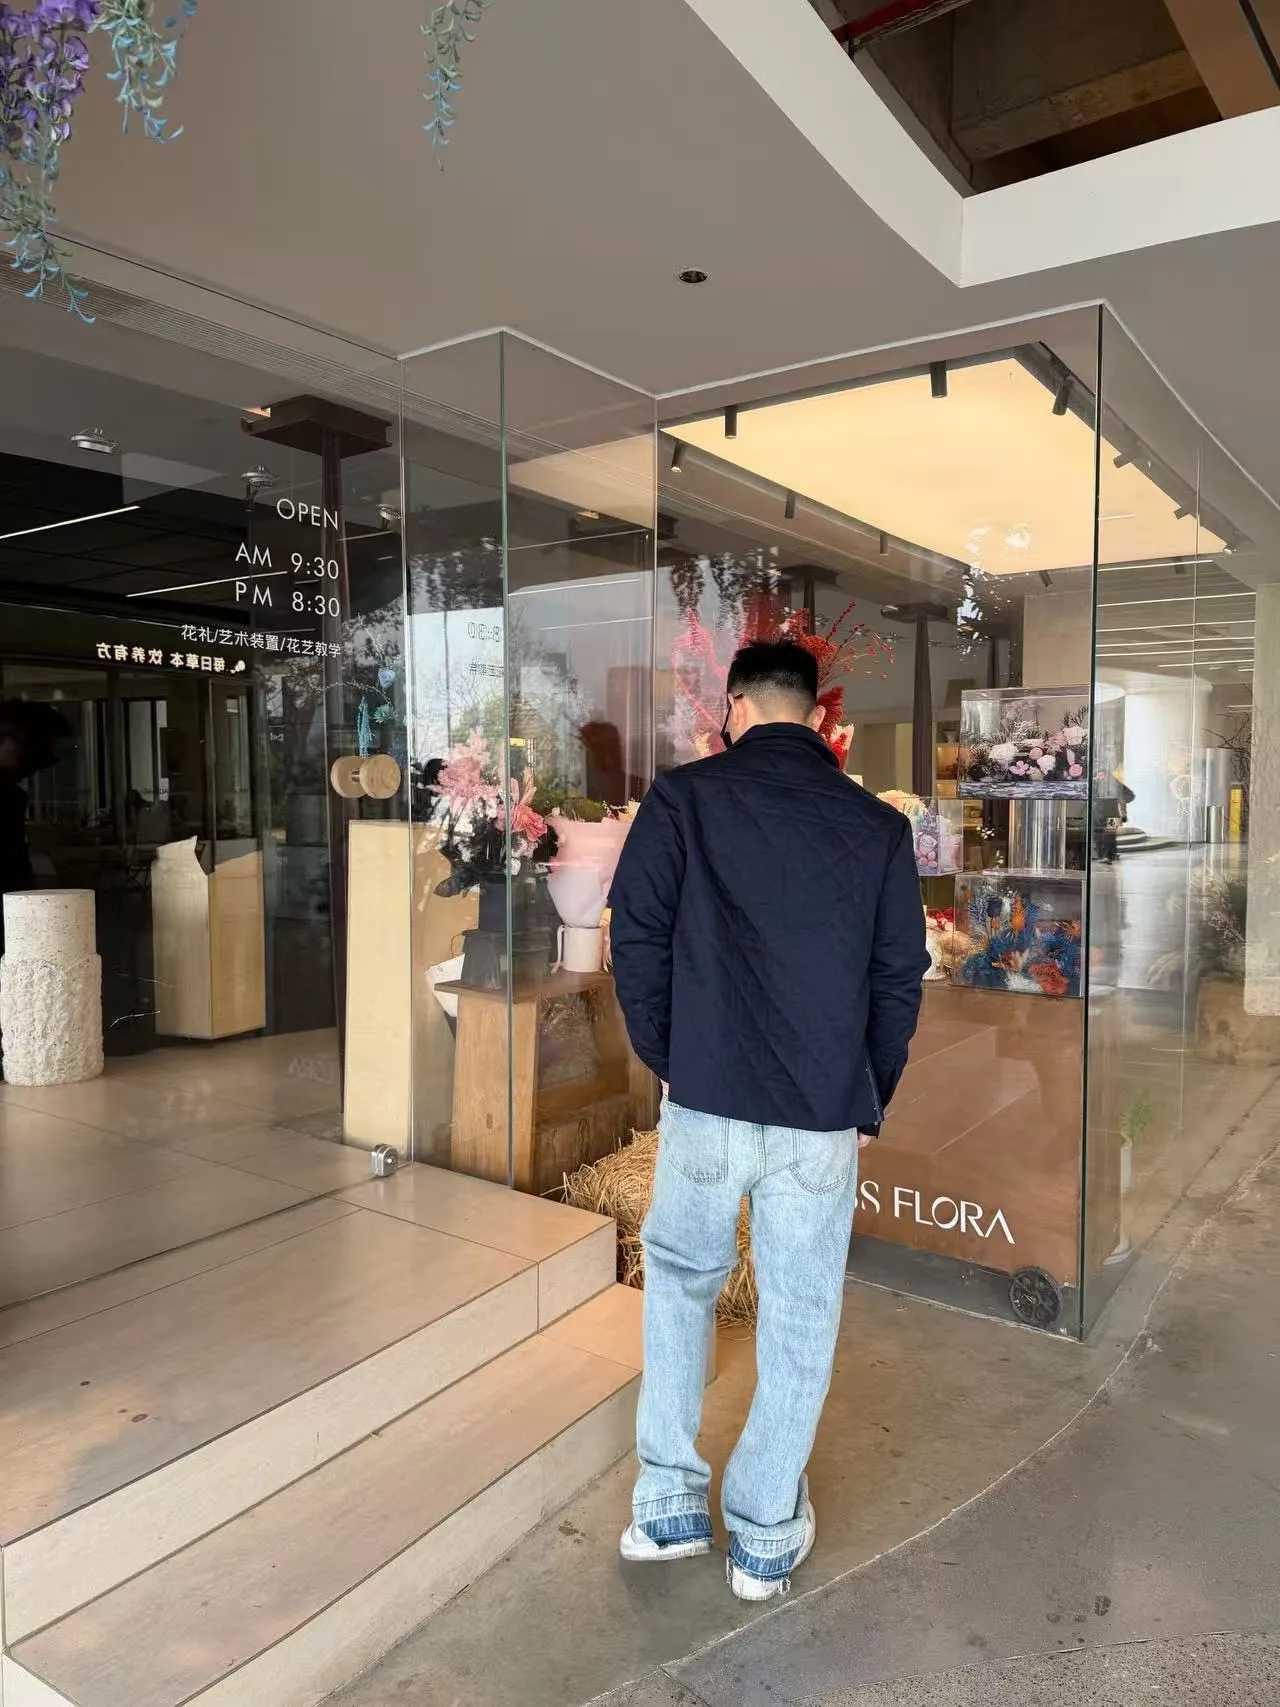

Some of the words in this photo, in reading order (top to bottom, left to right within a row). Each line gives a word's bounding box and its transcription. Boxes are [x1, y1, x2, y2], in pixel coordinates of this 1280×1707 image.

[276, 498, 340, 531] OPEN
[235, 542, 273, 568] AM
[291, 552, 339, 580] 9:30
[235, 581, 273, 607] PM
[292, 591, 341, 617] 8:30
[181, 624, 342, 657] 花礼/艺术装置/花艺教学
[893, 1186, 1016, 1245] FLORA
